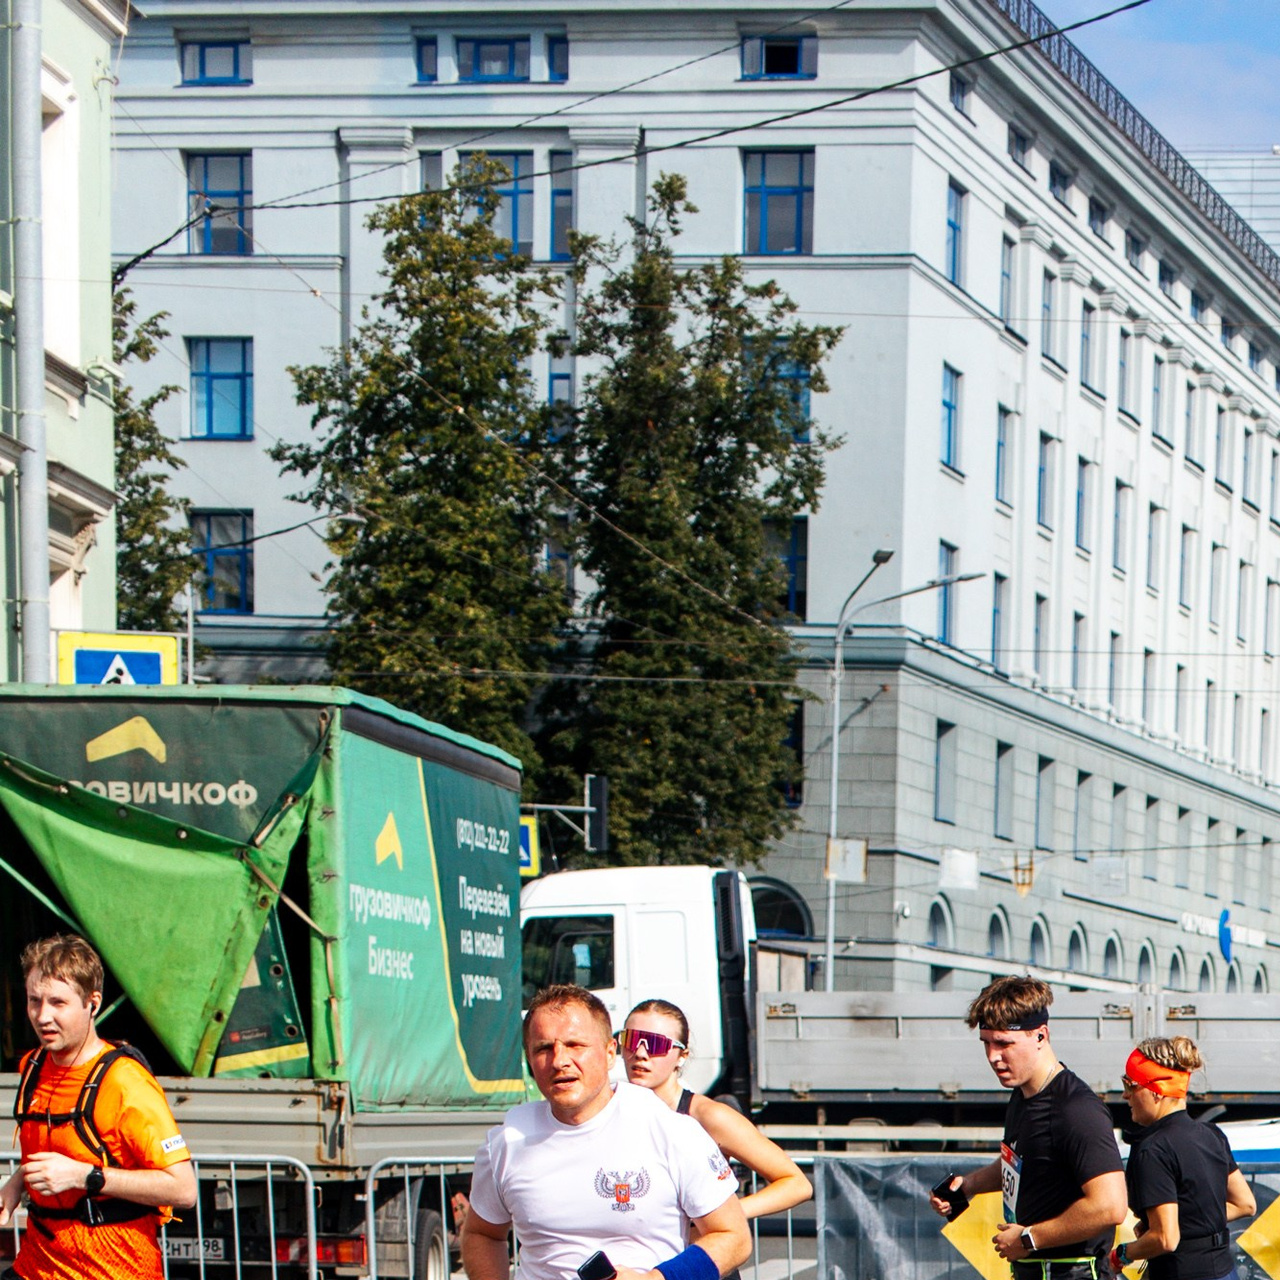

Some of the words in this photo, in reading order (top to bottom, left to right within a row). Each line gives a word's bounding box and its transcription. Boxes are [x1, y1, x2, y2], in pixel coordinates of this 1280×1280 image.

[349, 883, 431, 931] грузовичкоф
[458, 875, 511, 920] Перевезём
[368, 935, 414, 981] Бизнес
[460, 928, 474, 955] на
[474, 926, 505, 959] новый
[461, 973, 502, 1008] уровень
